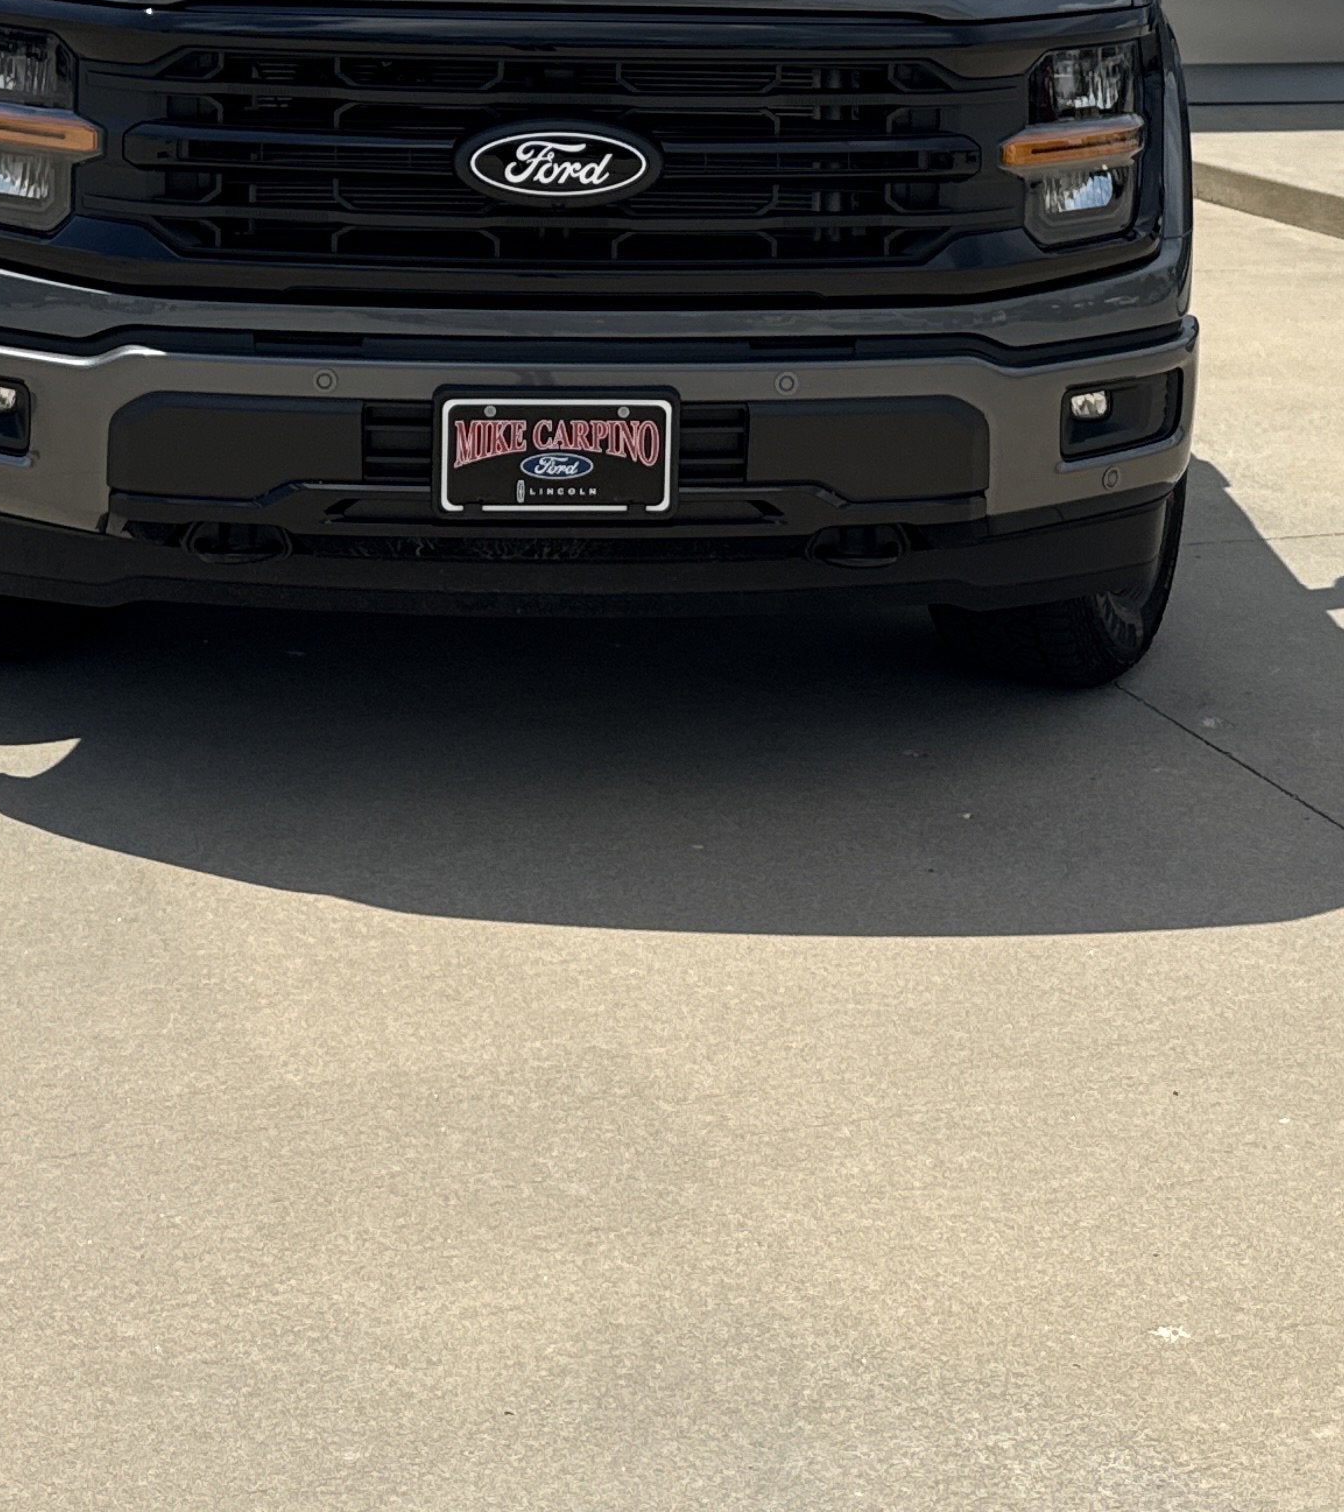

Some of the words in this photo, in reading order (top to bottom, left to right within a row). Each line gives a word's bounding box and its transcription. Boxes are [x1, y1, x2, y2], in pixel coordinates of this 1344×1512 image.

[504, 140, 614, 185] Ford
[453, 419, 528, 469] MIKE
[531, 419, 660, 467] CARPINO
[533, 455, 579, 475] Ford
[529, 487, 598, 496] LINCOLN
